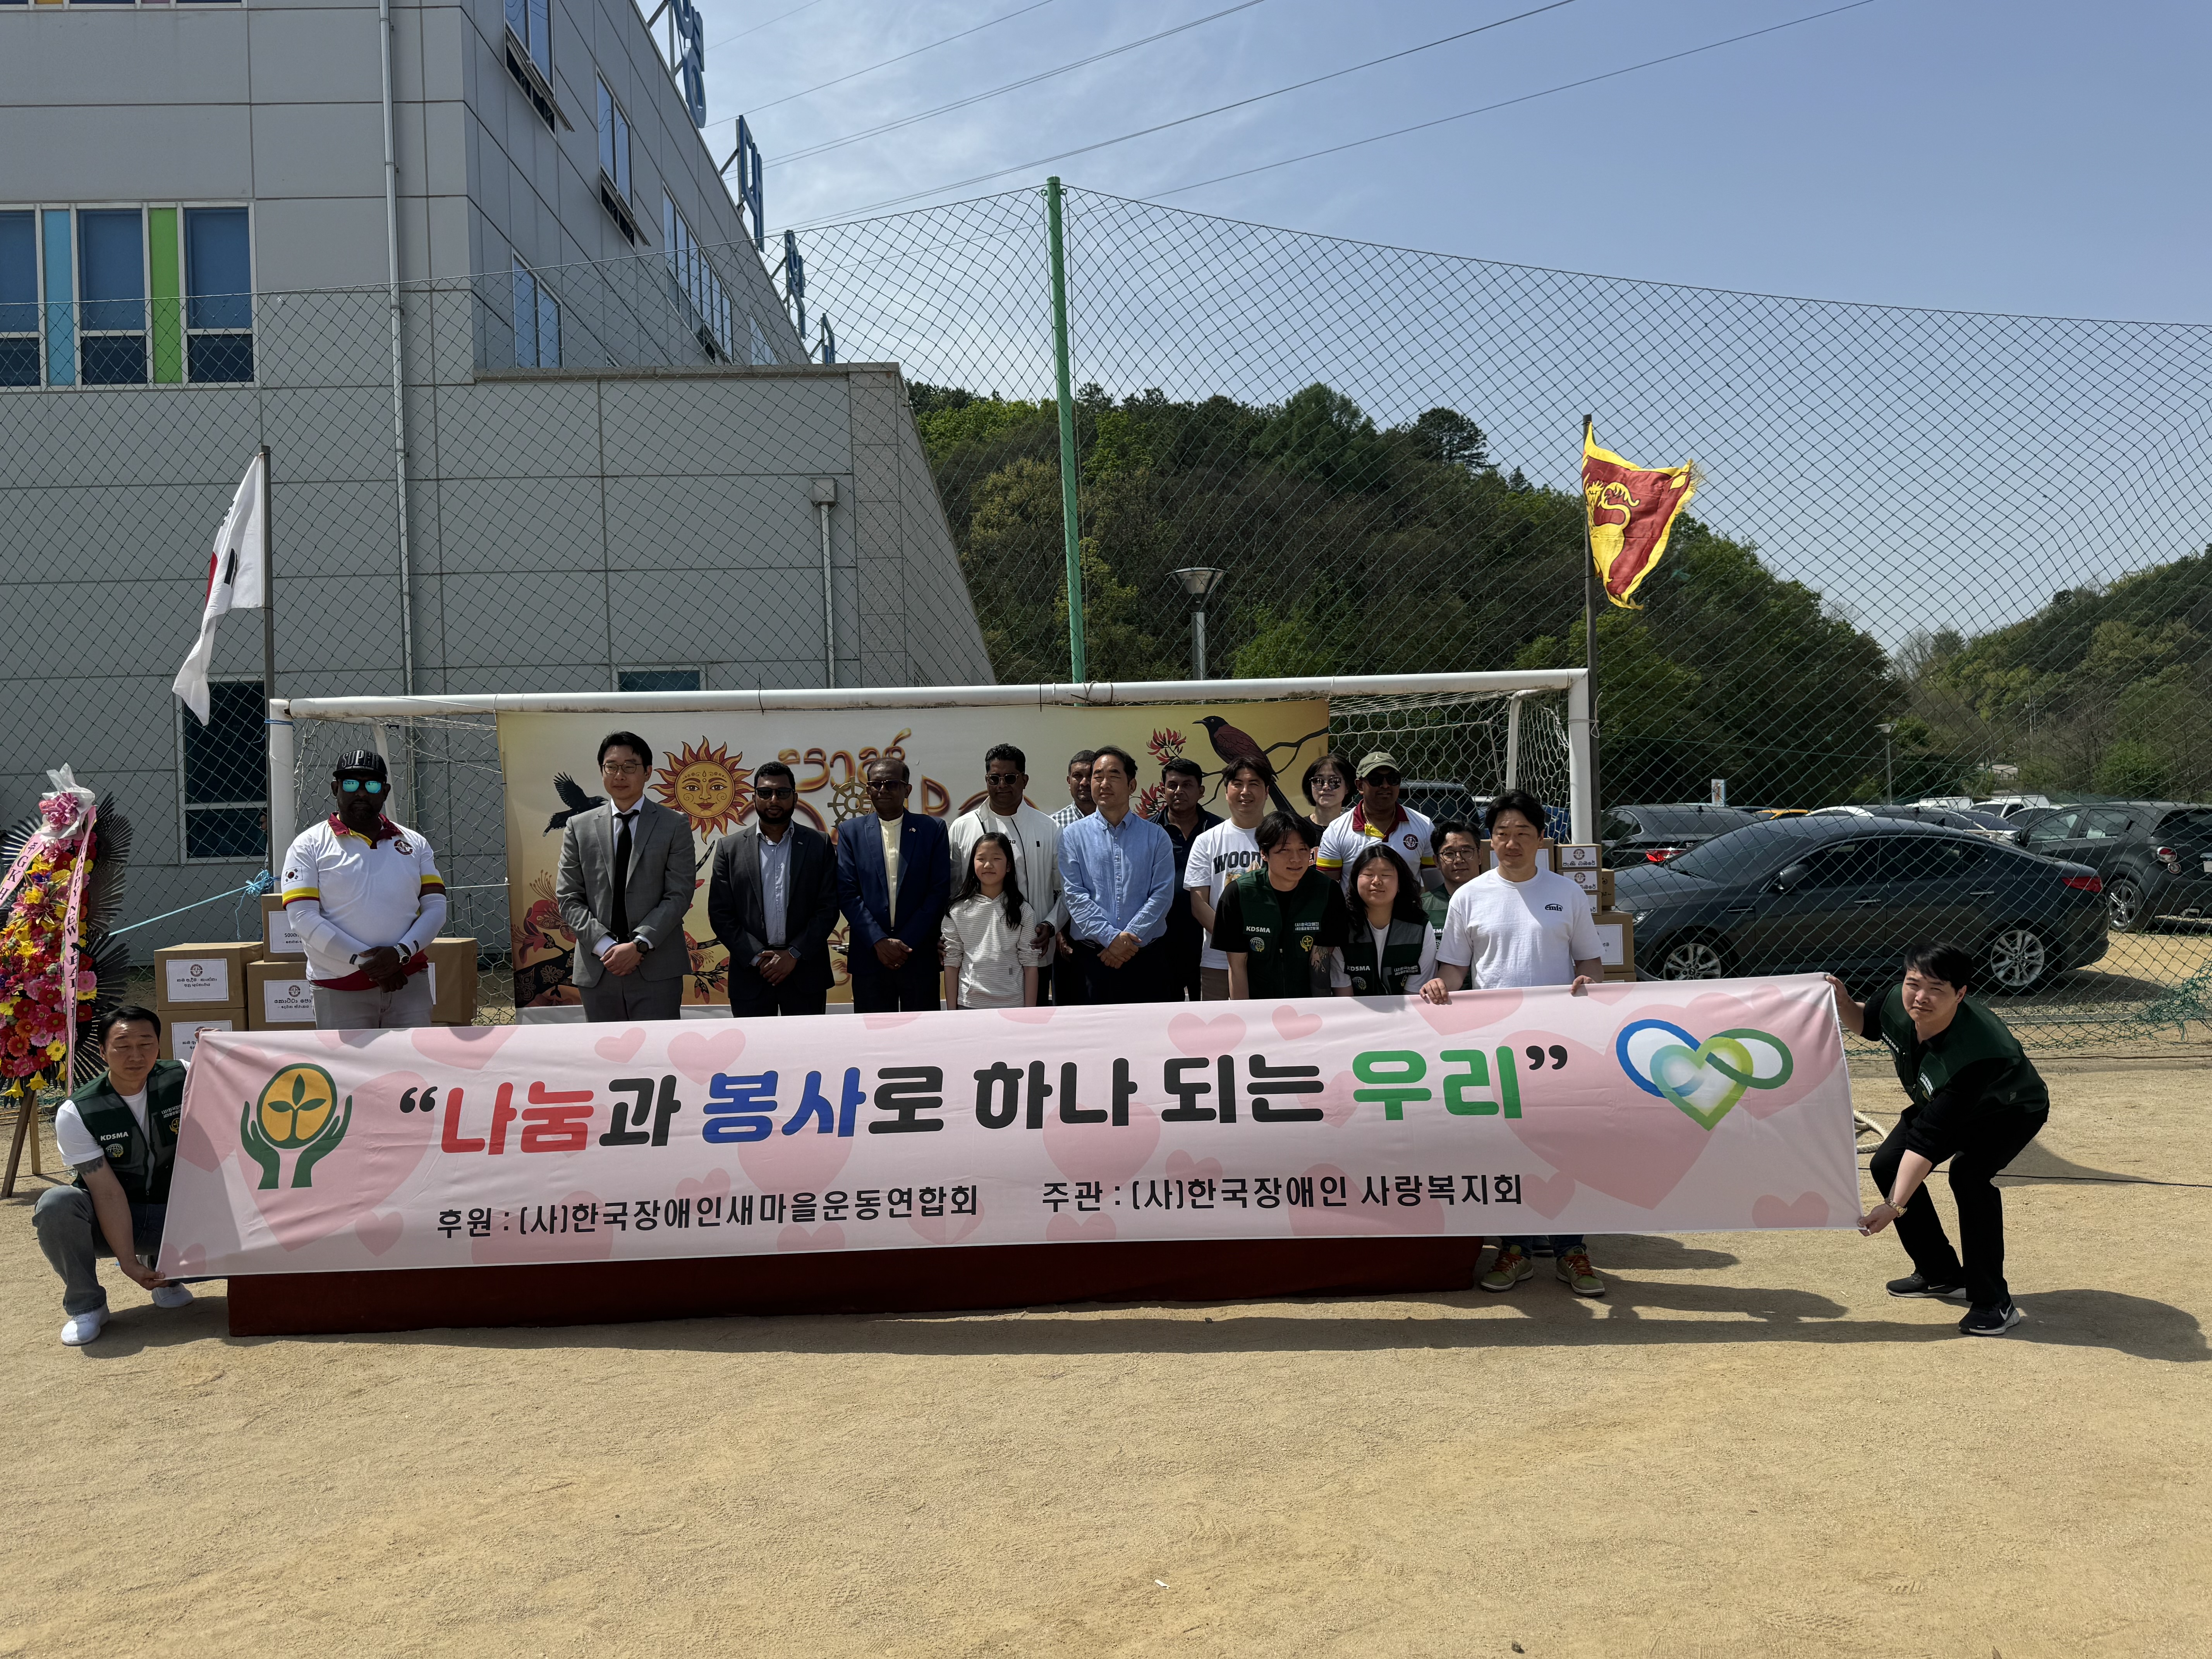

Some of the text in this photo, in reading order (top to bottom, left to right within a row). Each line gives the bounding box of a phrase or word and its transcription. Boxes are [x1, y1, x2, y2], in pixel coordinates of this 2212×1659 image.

[73, 844, 86, 897] HAPPY
[66, 903, 78, 936] NEW
[1882, 1032, 1899, 1053] KDSMA
[400, 1045, 1567, 1154] “나눔과 봉사로 하나 되는 우리”
[100, 1132, 129, 1141] KDSMA
[438, 1208, 491, 1238] 후원
[520, 1185, 976, 1235] (사)한국장애인새마을운동연합회
[1043, 1182, 1103, 1212] 주관
[1133, 1176, 1346, 1209] (사)한국장애인
[1361, 1175, 1521, 1206] 사랑복지회
